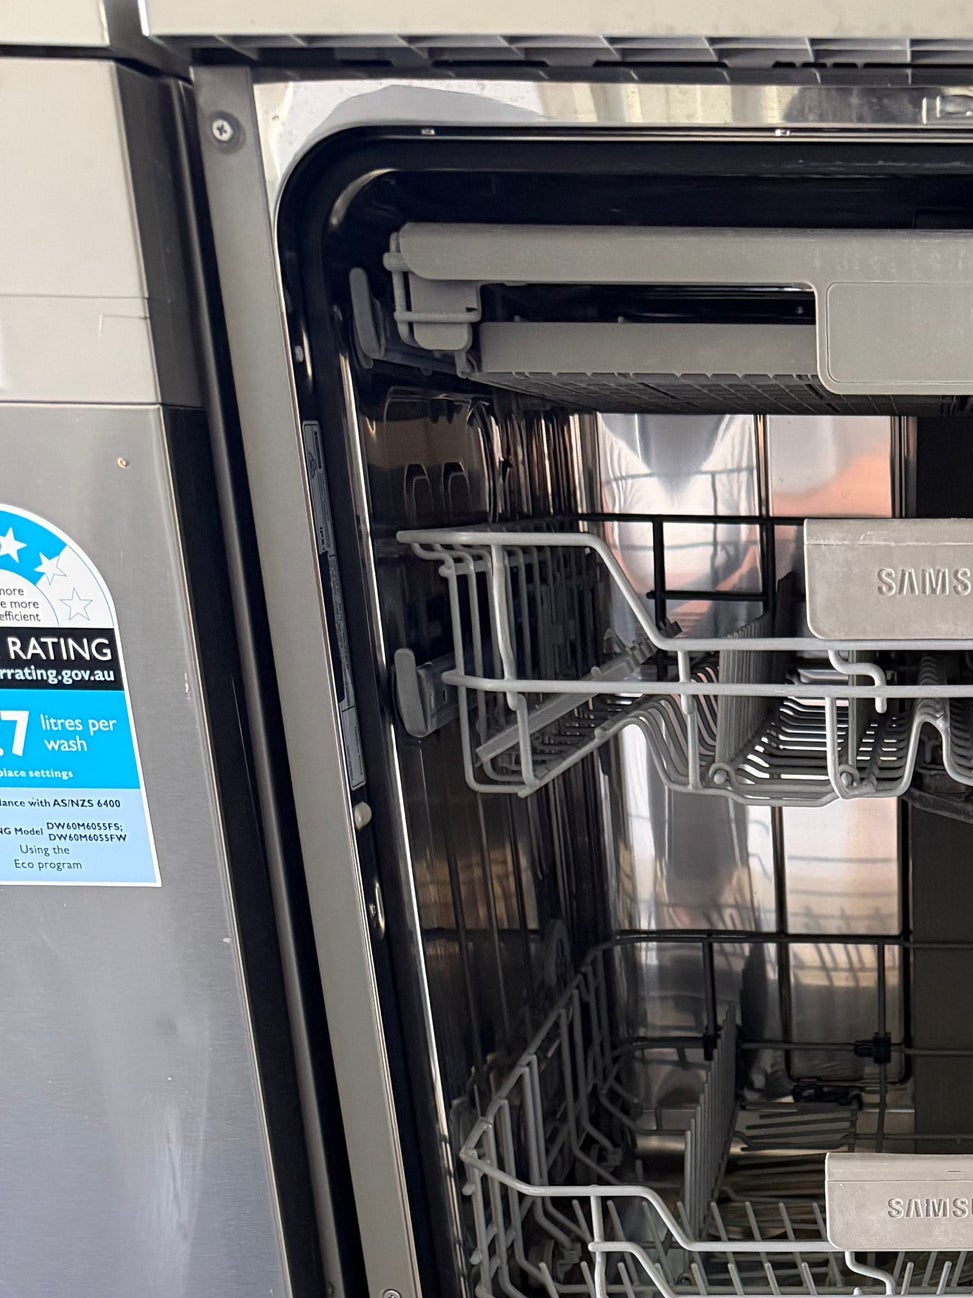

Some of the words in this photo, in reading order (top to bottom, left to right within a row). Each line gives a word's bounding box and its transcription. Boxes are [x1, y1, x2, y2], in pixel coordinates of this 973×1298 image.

[10, 601, 40, 609] more
[0, 610, 41, 622] efficient
[7, 636, 112, 661] RATING
[0, 665, 115, 685] rrating.gov.au
[40, 713, 83, 731] litres
[88, 718, 117, 736] per
[44, 735, 88, 752] wash
[28, 768, 74, 781] settings
[0, 798, 26, 807] ance
[28, 798, 51, 807] with
[53, 798, 94, 808] AS/NZS
[97, 799, 121, 808] 6400
[14, 827, 44, 836] Model
[19, 844, 50, 857] Using
[52, 845, 70, 855] the
[14, 859, 34, 869] Eco
[38, 861, 83, 872] program
